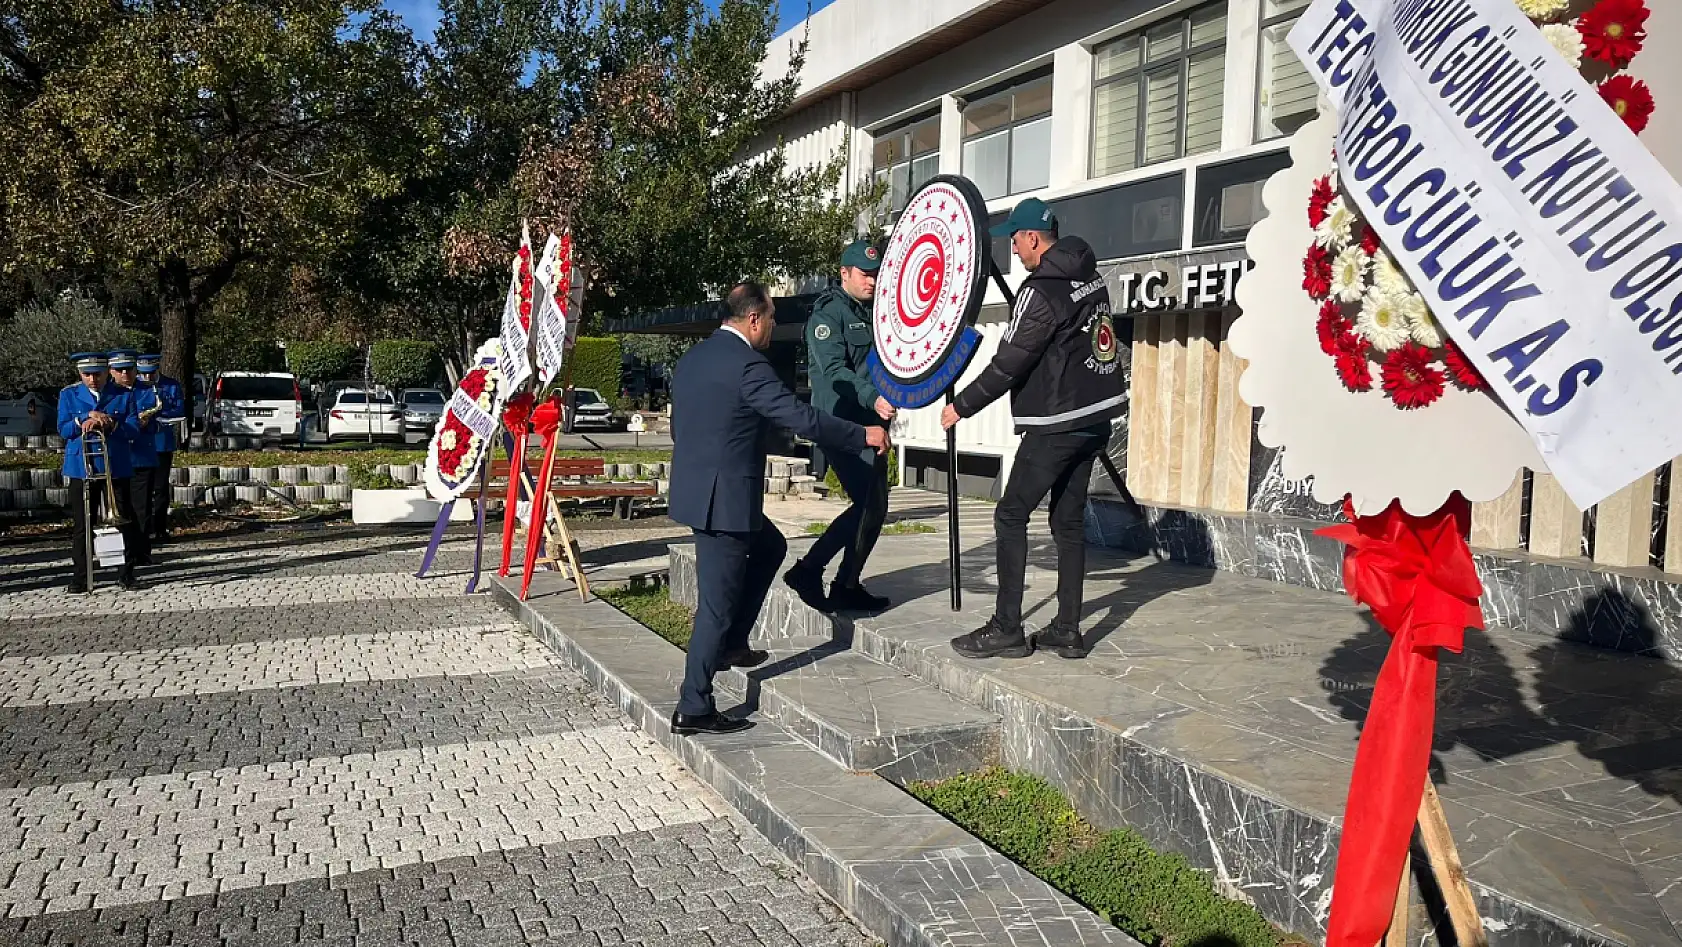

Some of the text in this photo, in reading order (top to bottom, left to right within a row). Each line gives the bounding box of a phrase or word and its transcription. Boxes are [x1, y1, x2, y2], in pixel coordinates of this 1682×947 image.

[1428, 25, 1578, 181] GÜNÜNÜZ
[1520, 137, 1667, 272] KUTLU
[1119, 259, 1248, 309] T.C. FET
